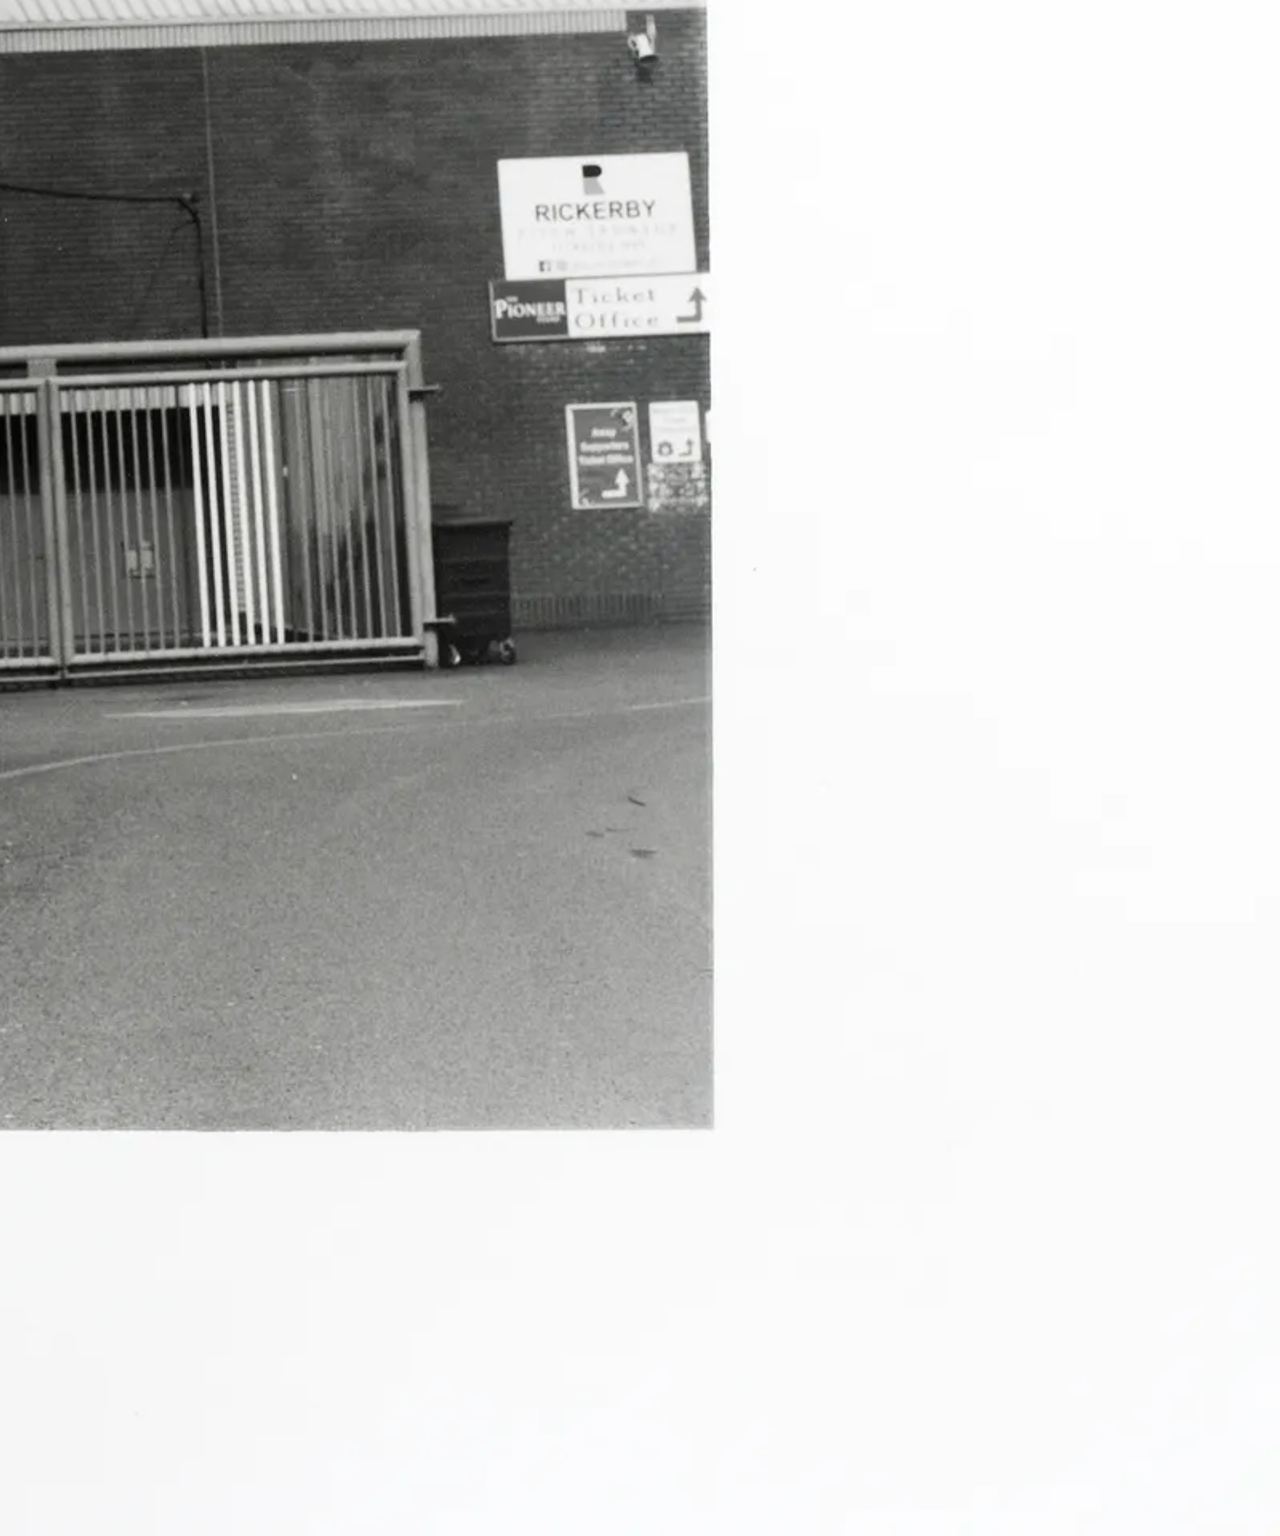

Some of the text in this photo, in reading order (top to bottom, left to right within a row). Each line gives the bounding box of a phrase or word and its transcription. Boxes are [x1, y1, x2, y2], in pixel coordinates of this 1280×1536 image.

[534, 199, 656, 223] RICKERBY
[572, 286, 656, 305] Ticket
[574, 310, 660, 329] Office
